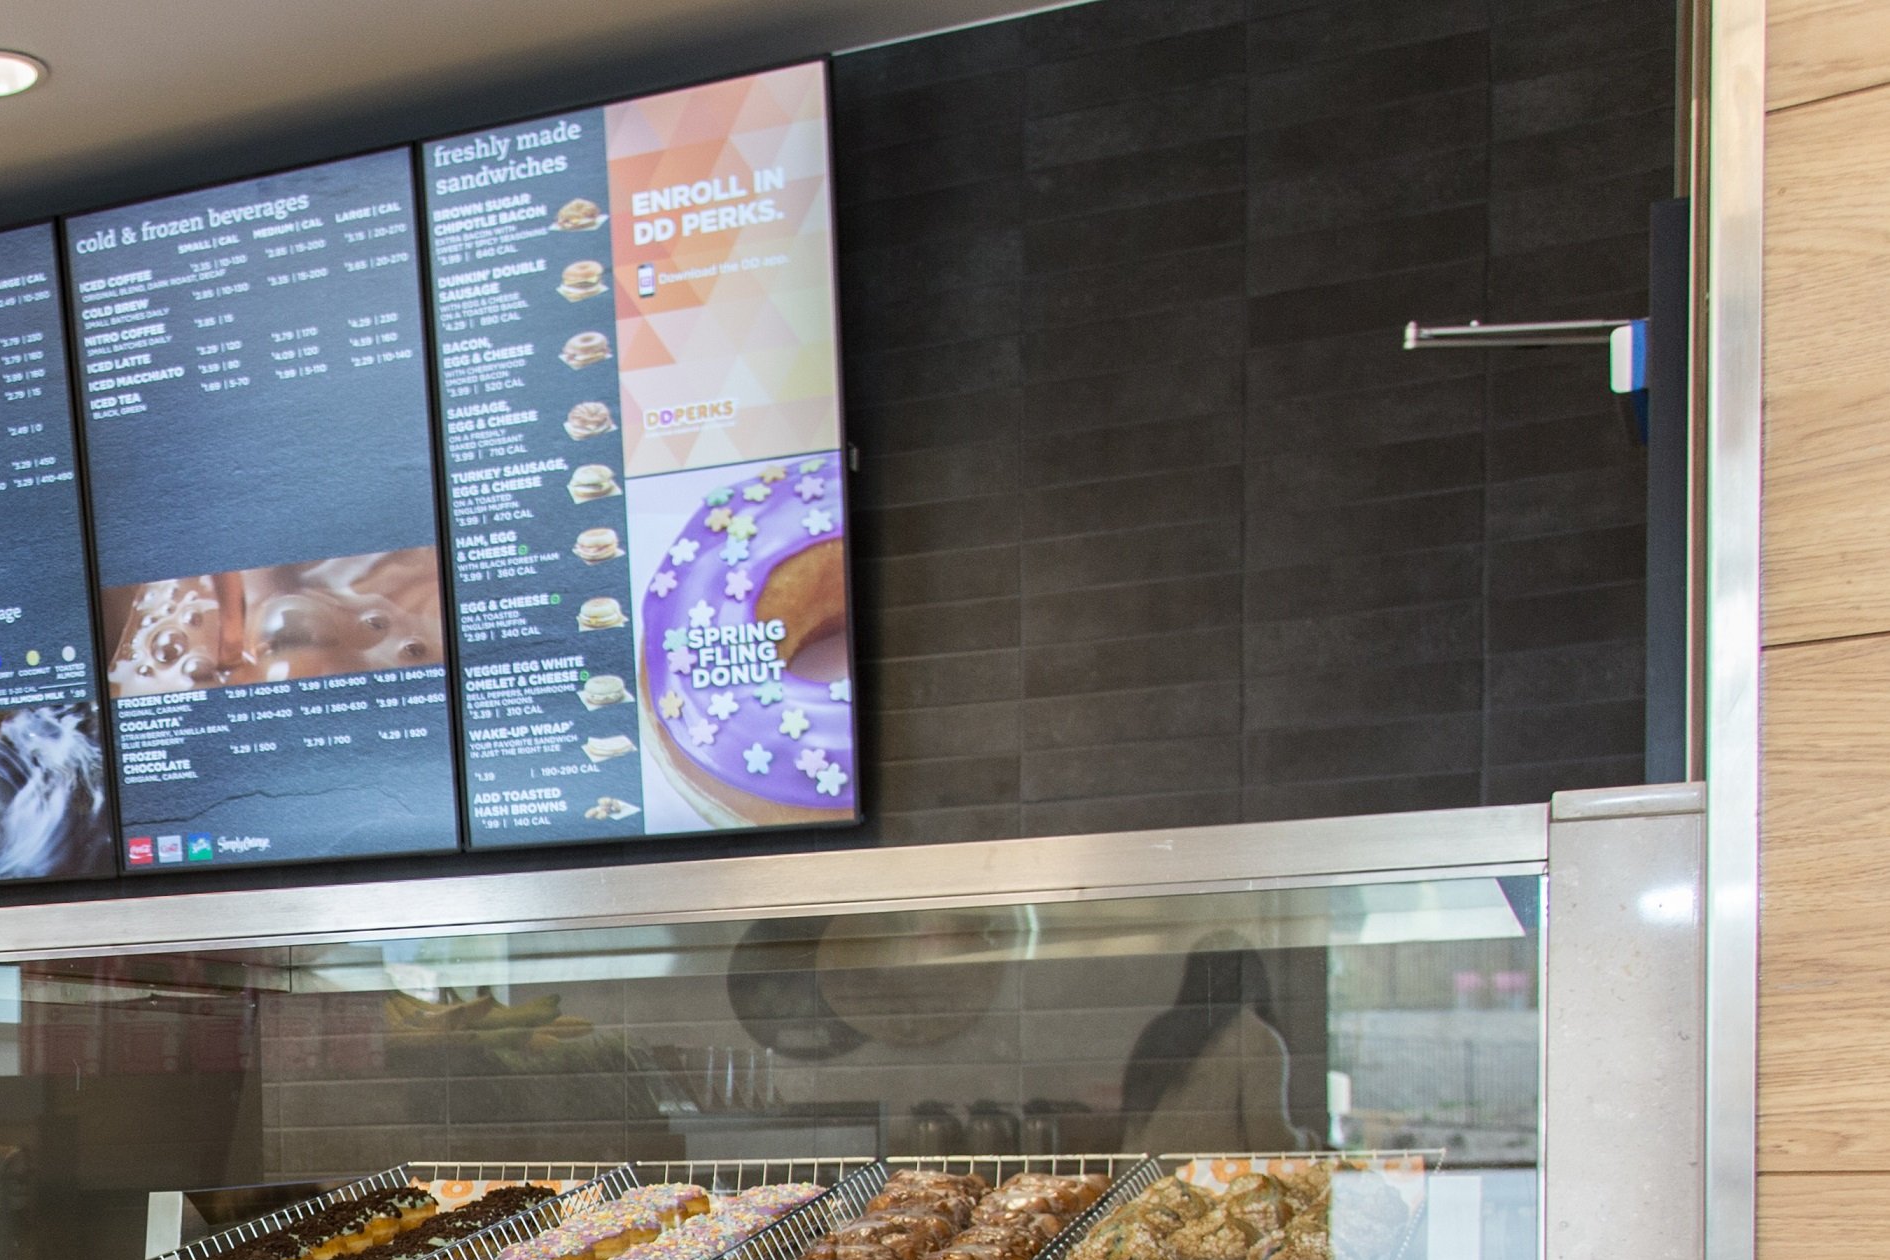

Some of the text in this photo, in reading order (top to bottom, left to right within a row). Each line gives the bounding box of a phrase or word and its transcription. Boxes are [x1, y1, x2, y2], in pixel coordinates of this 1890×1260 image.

[434, 120, 582, 168] freshly made
[436, 154, 568, 195] sandwiches
[632, 167, 785, 216] ENROLL IN
[77, 194, 310, 254] cold & frozen beverages
[633, 198, 785, 246] DD PERKS.
[79, 278, 107, 294] ICED
[109, 270, 153, 288] COFFEE
[82, 299, 149, 321] COLD BREW
[85, 323, 166, 347] NITRO COFFEE
[87, 354, 152, 374] ICED LATTE
[461, 594, 549, 614] EGG & CHEESE
[688, 620, 786, 649] SPRING
[699, 642, 778, 667] FLING
[692, 660, 787, 688] DONUT
[470, 726, 529, 741] WAKE-UP
[123, 751, 167, 762] FROZEN
[124, 760, 192, 775] CHOCOLATE
[475, 788, 561, 805] ADD TOASTED
[475, 801, 567, 818] HASH BROWNS
